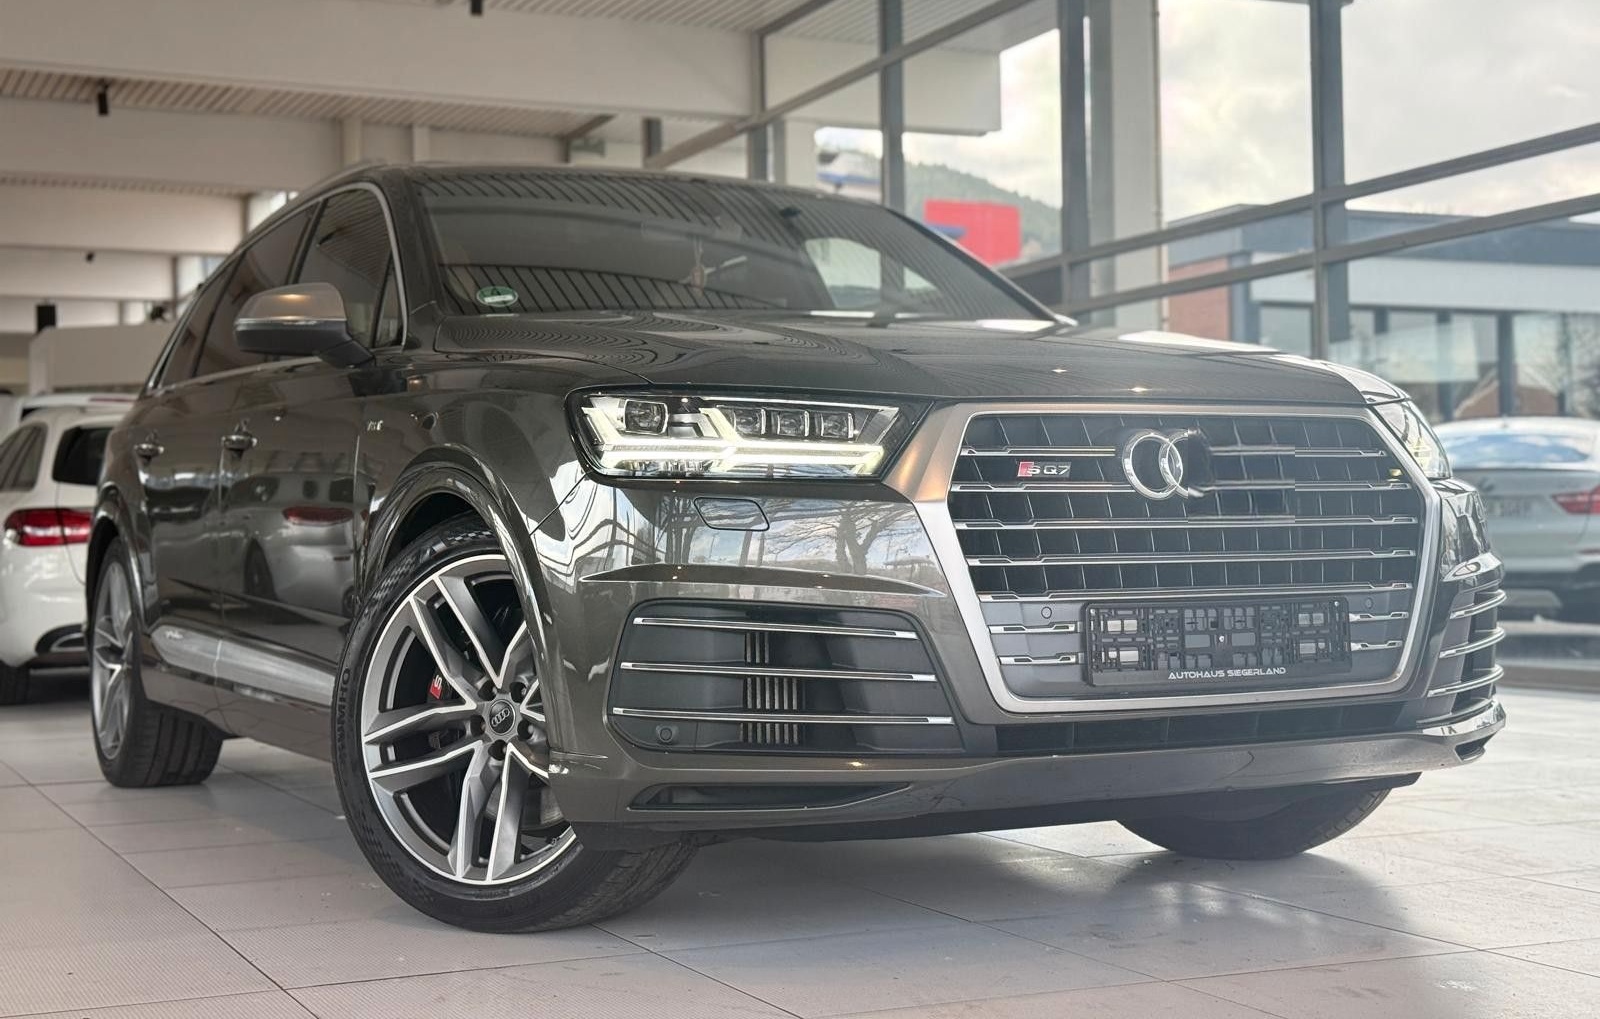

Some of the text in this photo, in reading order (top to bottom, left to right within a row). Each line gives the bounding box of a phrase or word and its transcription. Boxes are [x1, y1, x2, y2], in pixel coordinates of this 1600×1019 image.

[1025, 464, 1071, 476] SQ7
[1168, 666, 1287, 680] AUTOHAUS SIEGERLAND
